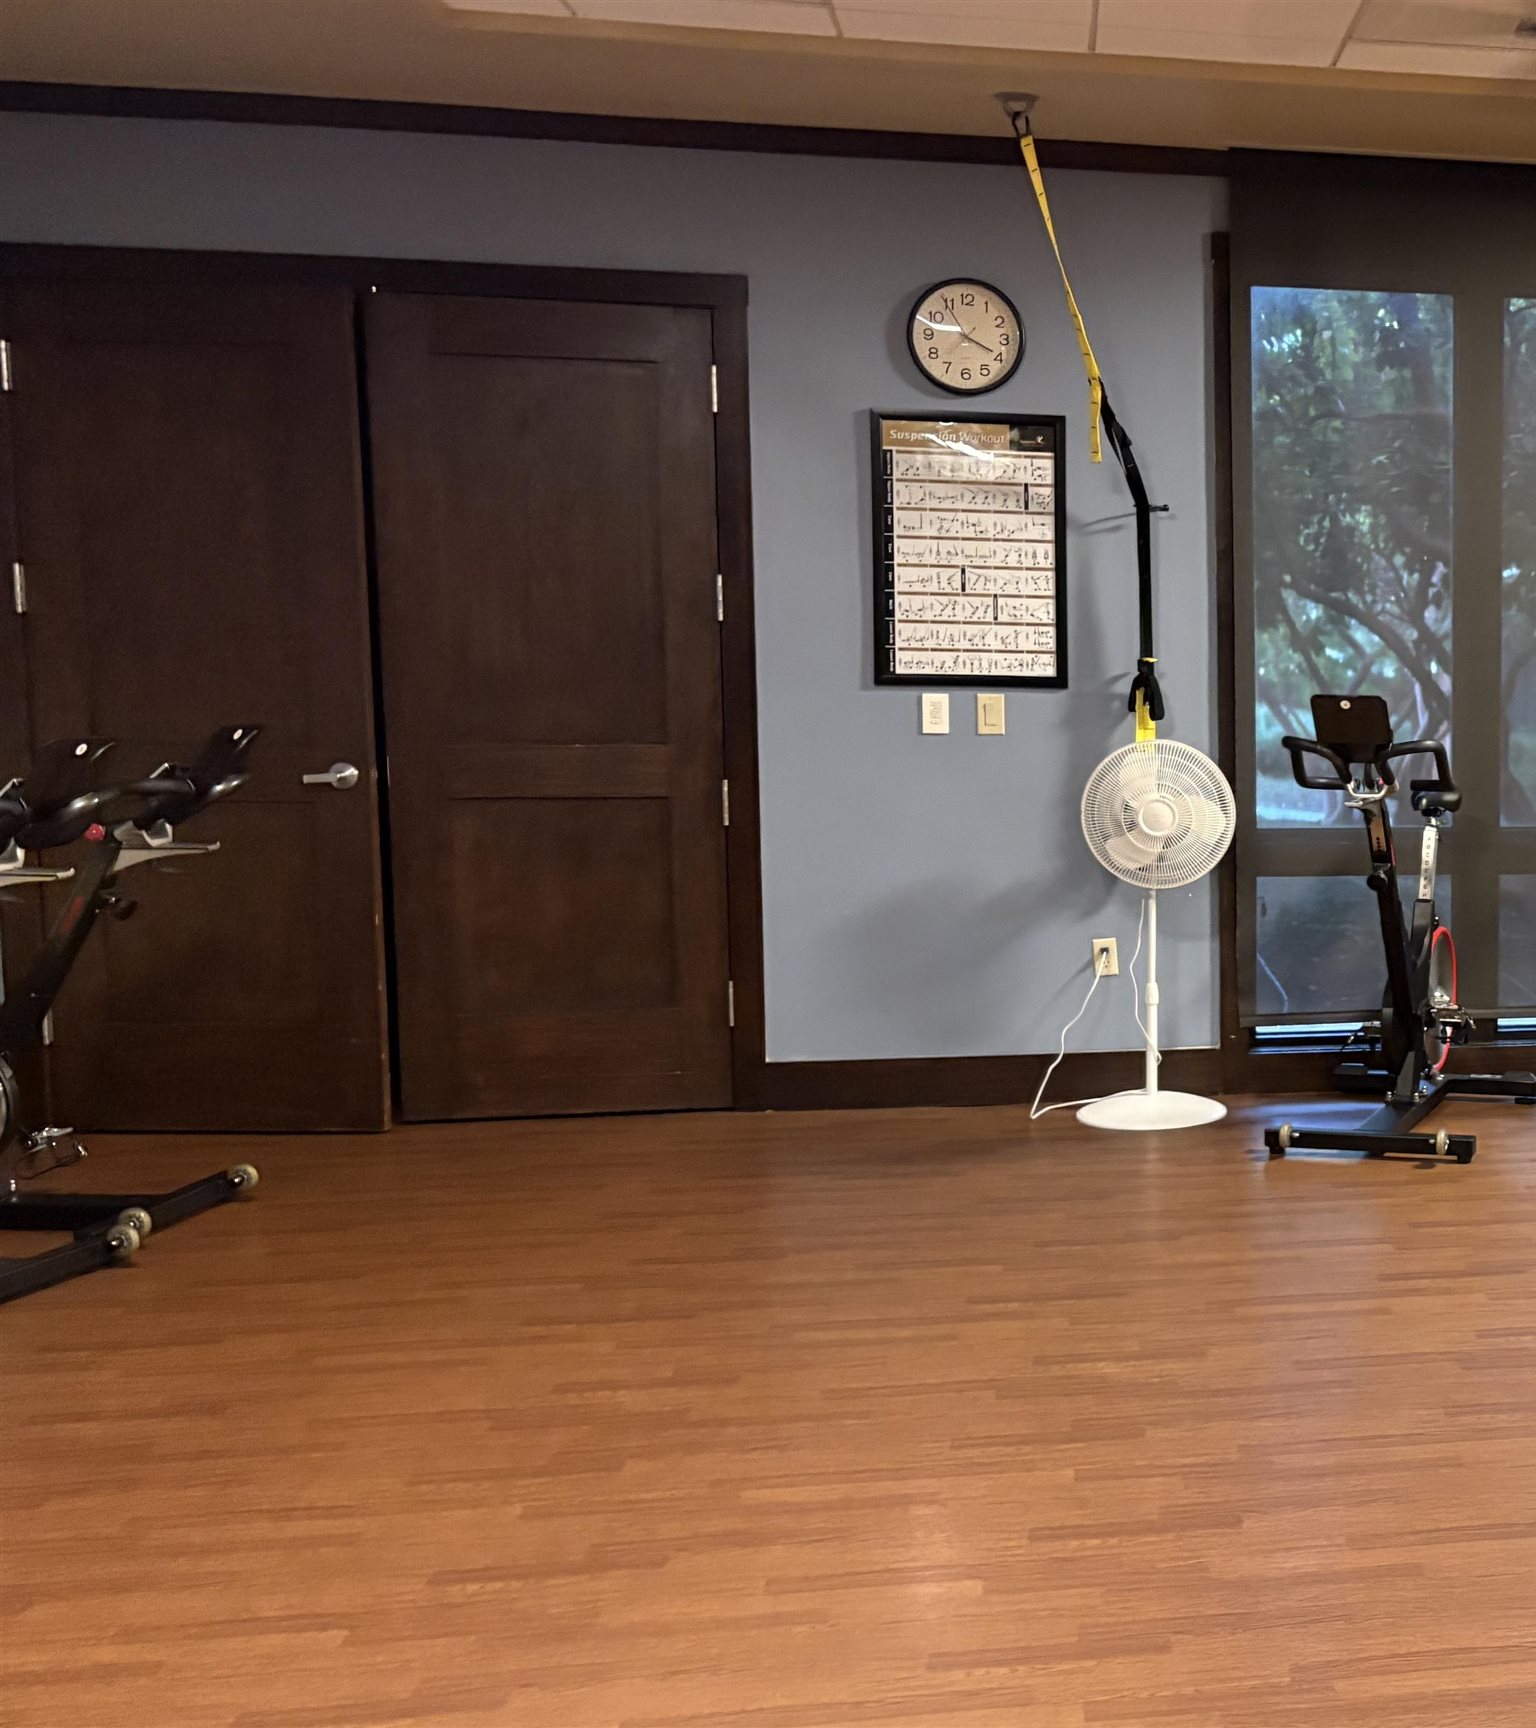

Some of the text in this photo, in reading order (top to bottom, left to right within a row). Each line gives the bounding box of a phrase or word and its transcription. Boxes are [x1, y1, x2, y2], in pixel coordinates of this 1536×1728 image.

[944, 298, 955, 310] 11
[960, 293, 975, 306] 12
[984, 301, 989, 313] 1
[928, 311, 944, 323] 10
[994, 316, 1005, 328] 2
[923, 328, 934, 340] 9
[999, 334, 1009, 346] 3
[928, 347, 938, 359] 8
[994, 352, 1003, 364] 4
[942, 361, 952, 374] 7
[980, 364, 990, 376] 5
[960, 368, 971, 380] 6
[889, 429, 1004, 444] Suspeion Workout
